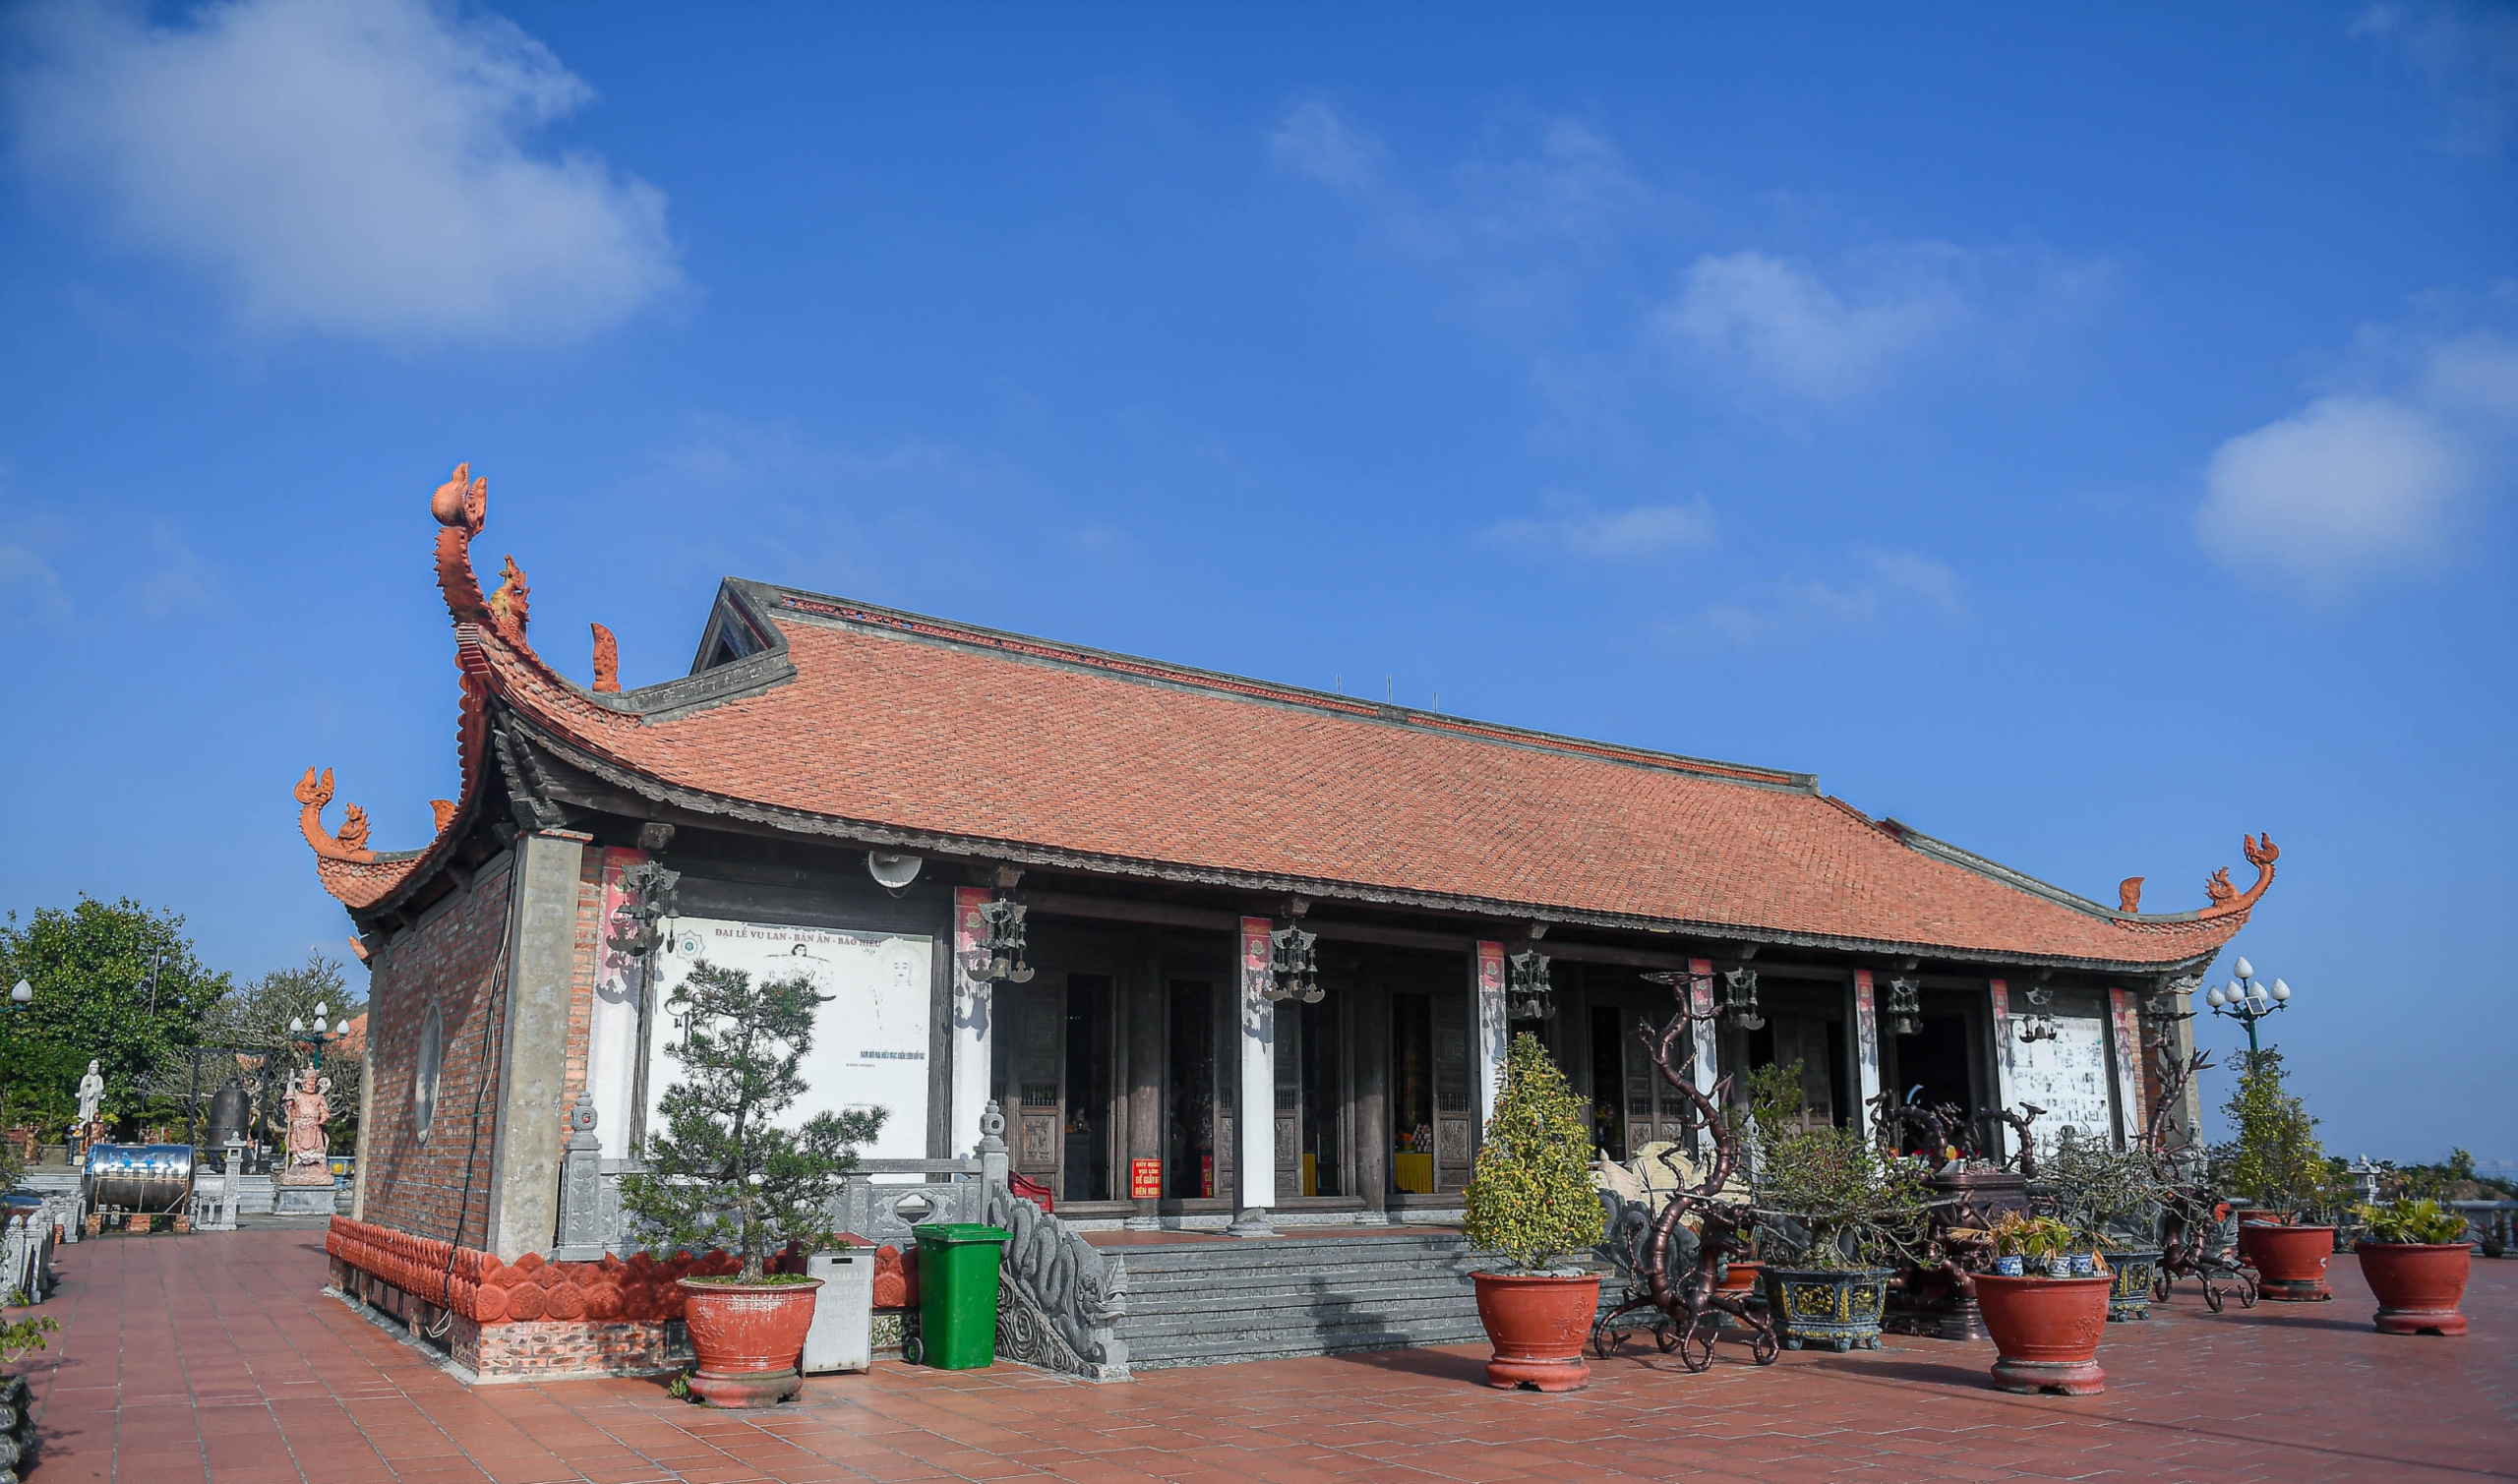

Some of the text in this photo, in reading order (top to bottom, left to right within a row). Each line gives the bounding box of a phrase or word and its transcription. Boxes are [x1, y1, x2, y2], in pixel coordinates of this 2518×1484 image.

[715, 927, 734, 939] ĐẠI
[736, 925, 748, 939] LỄ
[750, 930, 764, 940] VU
[767, 931, 787, 941] LAN
[816, 932, 831, 944] ÂN
[838, 934, 857, 946] BÁO
